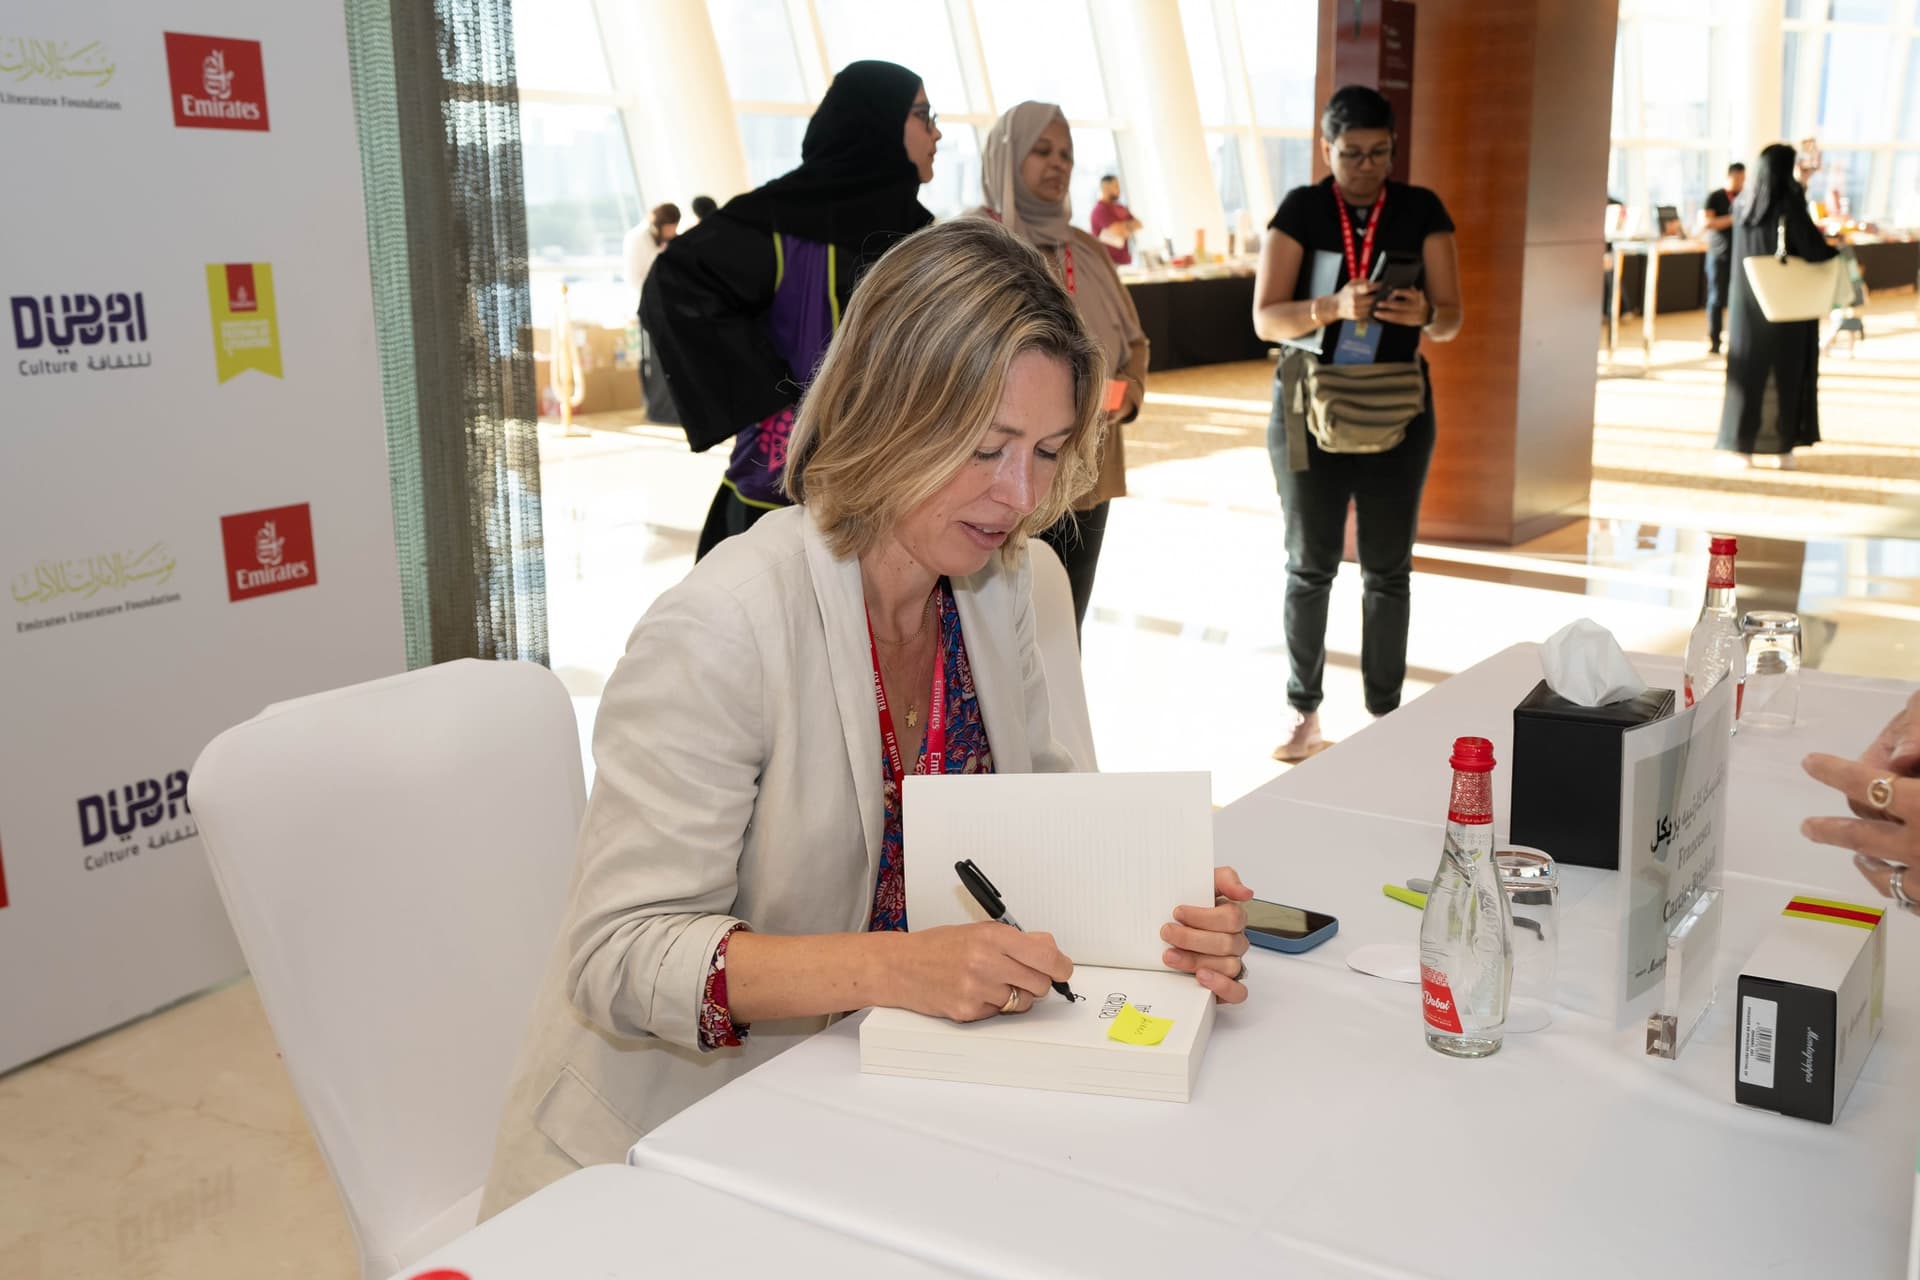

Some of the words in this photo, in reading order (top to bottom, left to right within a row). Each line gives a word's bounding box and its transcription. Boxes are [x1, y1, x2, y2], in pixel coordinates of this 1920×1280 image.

[181, 94, 260, 120] Emirates
[10, 292, 148, 354] DUBAI
[18, 359, 78, 377] Culture
[236, 561, 309, 590] Emirates
[16, 614, 67, 633] Emirates
[69, 604, 123, 623] Literature
[125, 593, 181, 611] Foundation
[931, 680, 942, 730] Emirates
[885, 731, 896, 745] FLY
[888, 744, 902, 772] BETTER
[77, 770, 192, 848] DUBA
[83, 844, 140, 872] Culture
